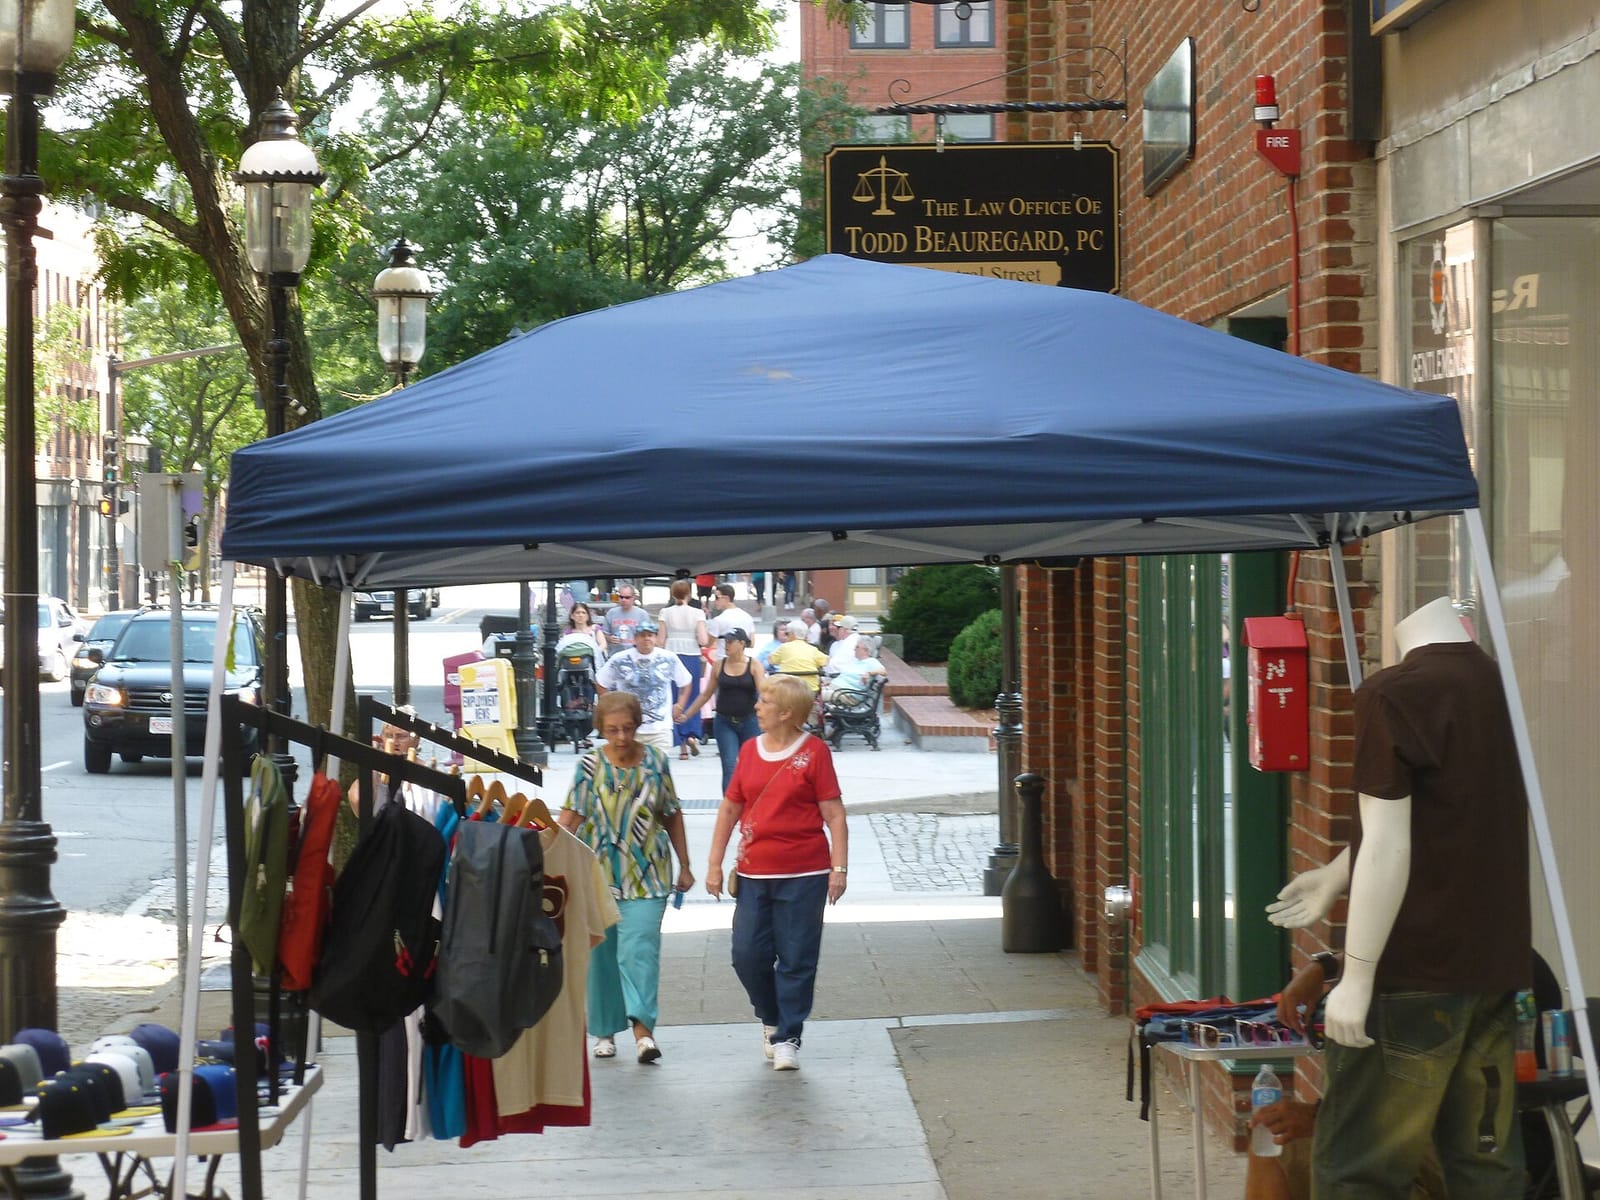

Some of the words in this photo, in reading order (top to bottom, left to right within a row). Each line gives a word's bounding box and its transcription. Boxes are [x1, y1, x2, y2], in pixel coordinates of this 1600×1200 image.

[1265, 136, 1289, 148] FIRE
[922, 199, 959, 217] THE
[964, 198, 1005, 216] LAW
[1009, 197, 1072, 216] OFFICE
[844, 226, 908, 254] TODD
[913, 225, 1070, 256] BEAUREGARD,
[1076, 229, 1104, 251] PC
[991, 266, 1041, 282] Street
